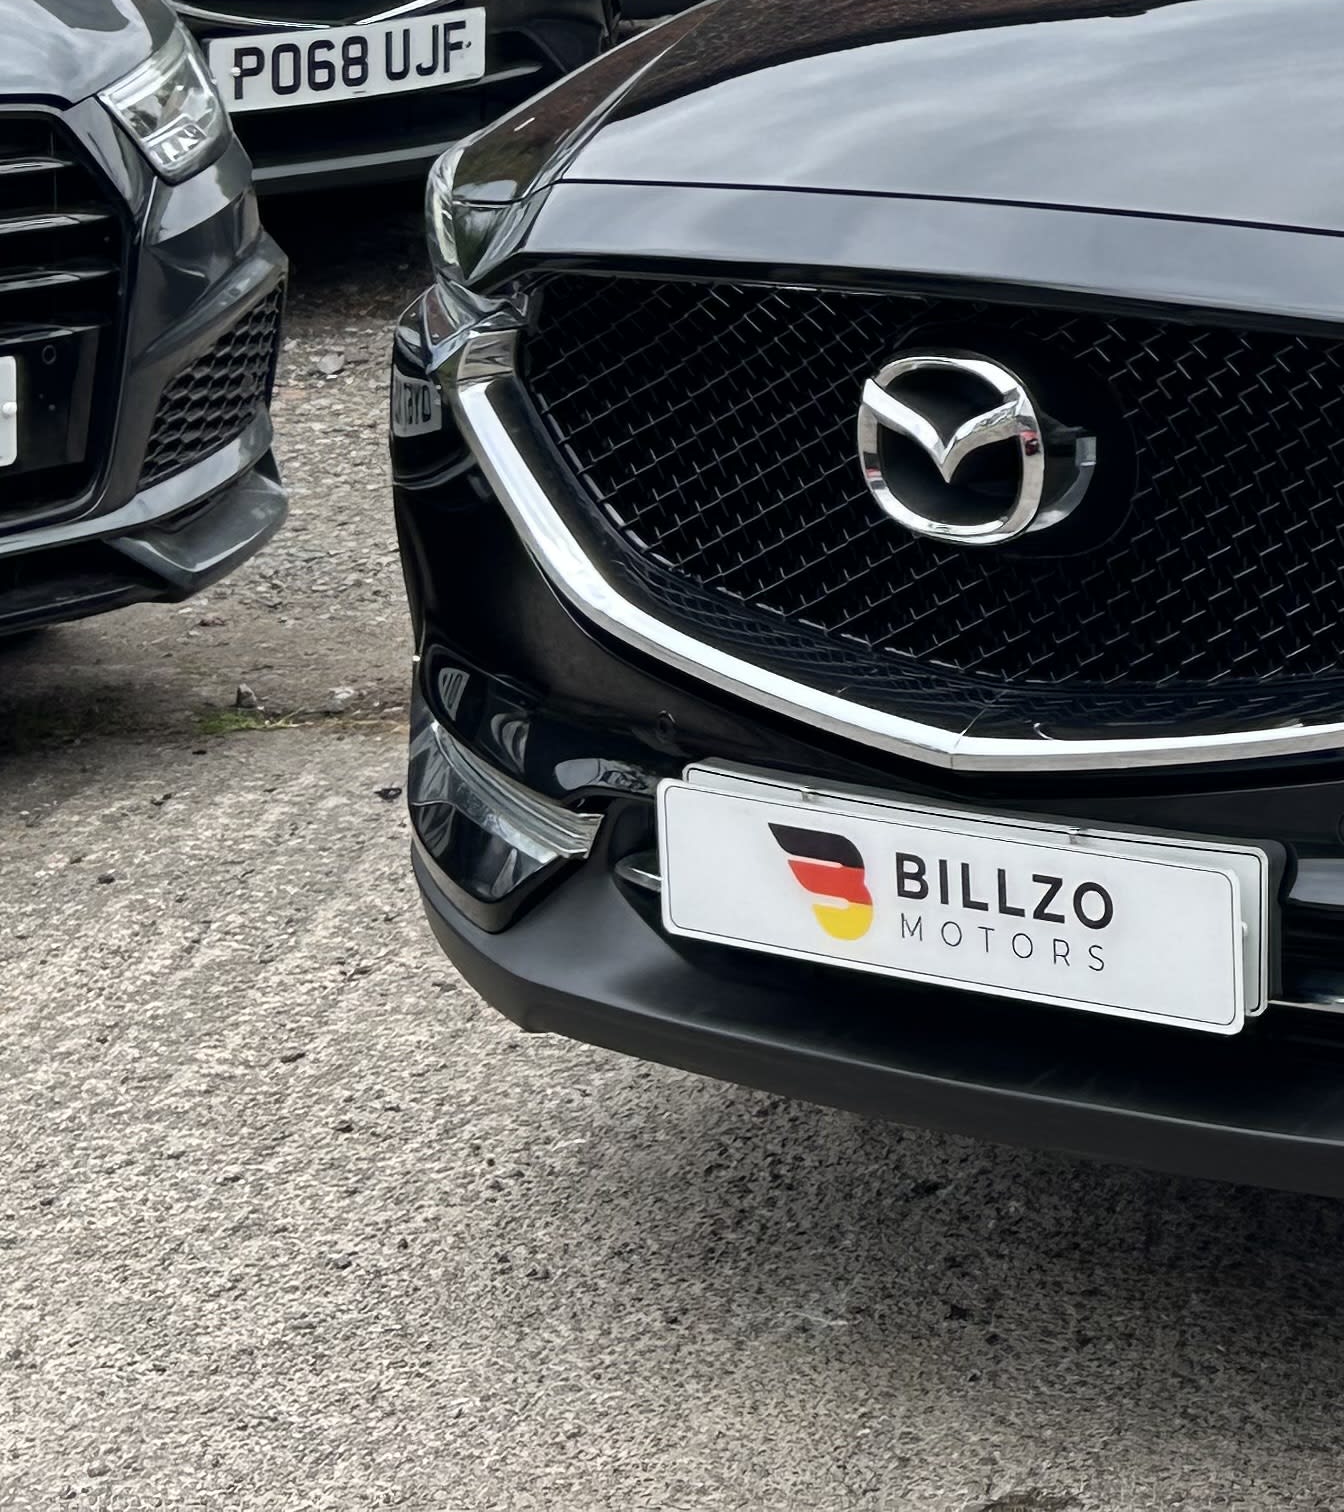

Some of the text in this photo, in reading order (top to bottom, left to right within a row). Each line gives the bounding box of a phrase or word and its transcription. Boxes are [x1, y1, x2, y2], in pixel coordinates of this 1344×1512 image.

[233, 20, 466, 99] PO68 UJF
[895, 851, 1114, 930] BILLZO
[901, 913, 1106, 972] MOTORS
